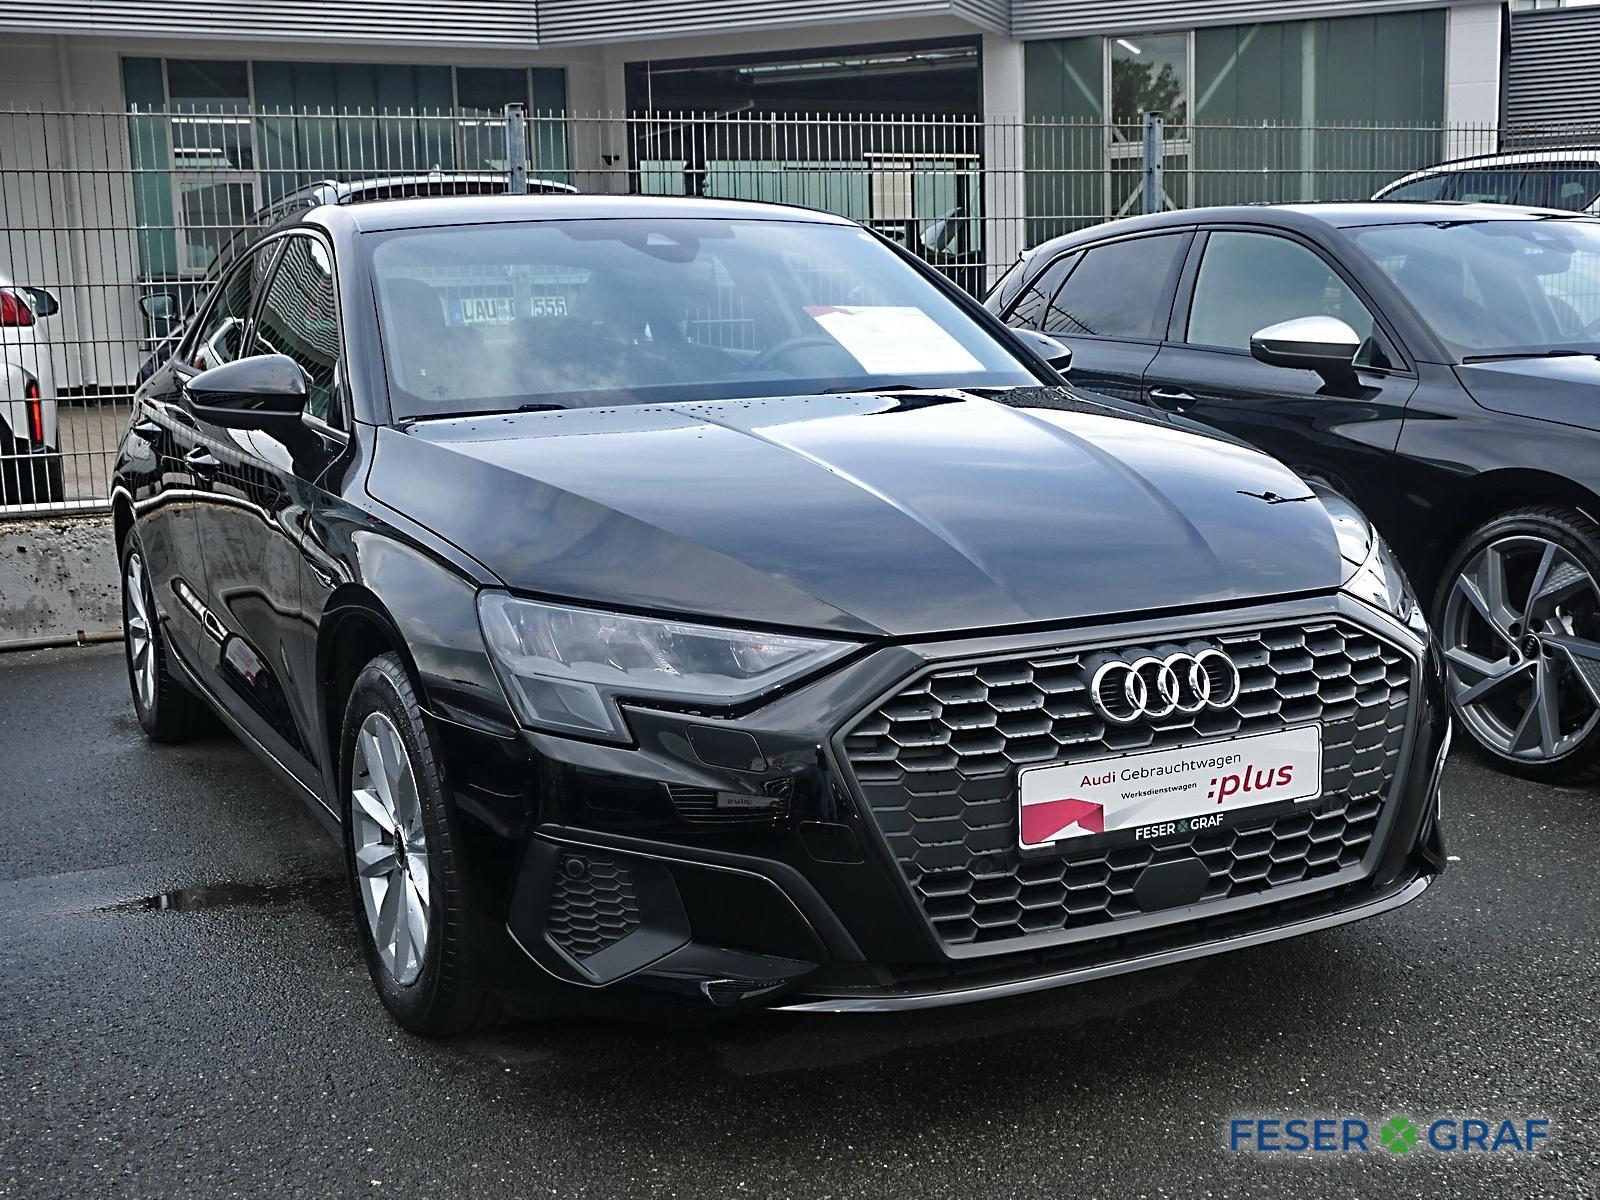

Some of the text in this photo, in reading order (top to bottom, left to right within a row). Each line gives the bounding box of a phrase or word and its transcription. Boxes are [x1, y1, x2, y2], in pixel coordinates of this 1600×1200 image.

[462, 300, 497, 321] LAU
[1080, 752, 1242, 788] Audi Gebrauchtwagen
[1121, 781, 1198, 800] Werksdienstwagen
[1207, 763, 1294, 805] :plus
[1135, 814, 1224, 841] FESER GRAF
